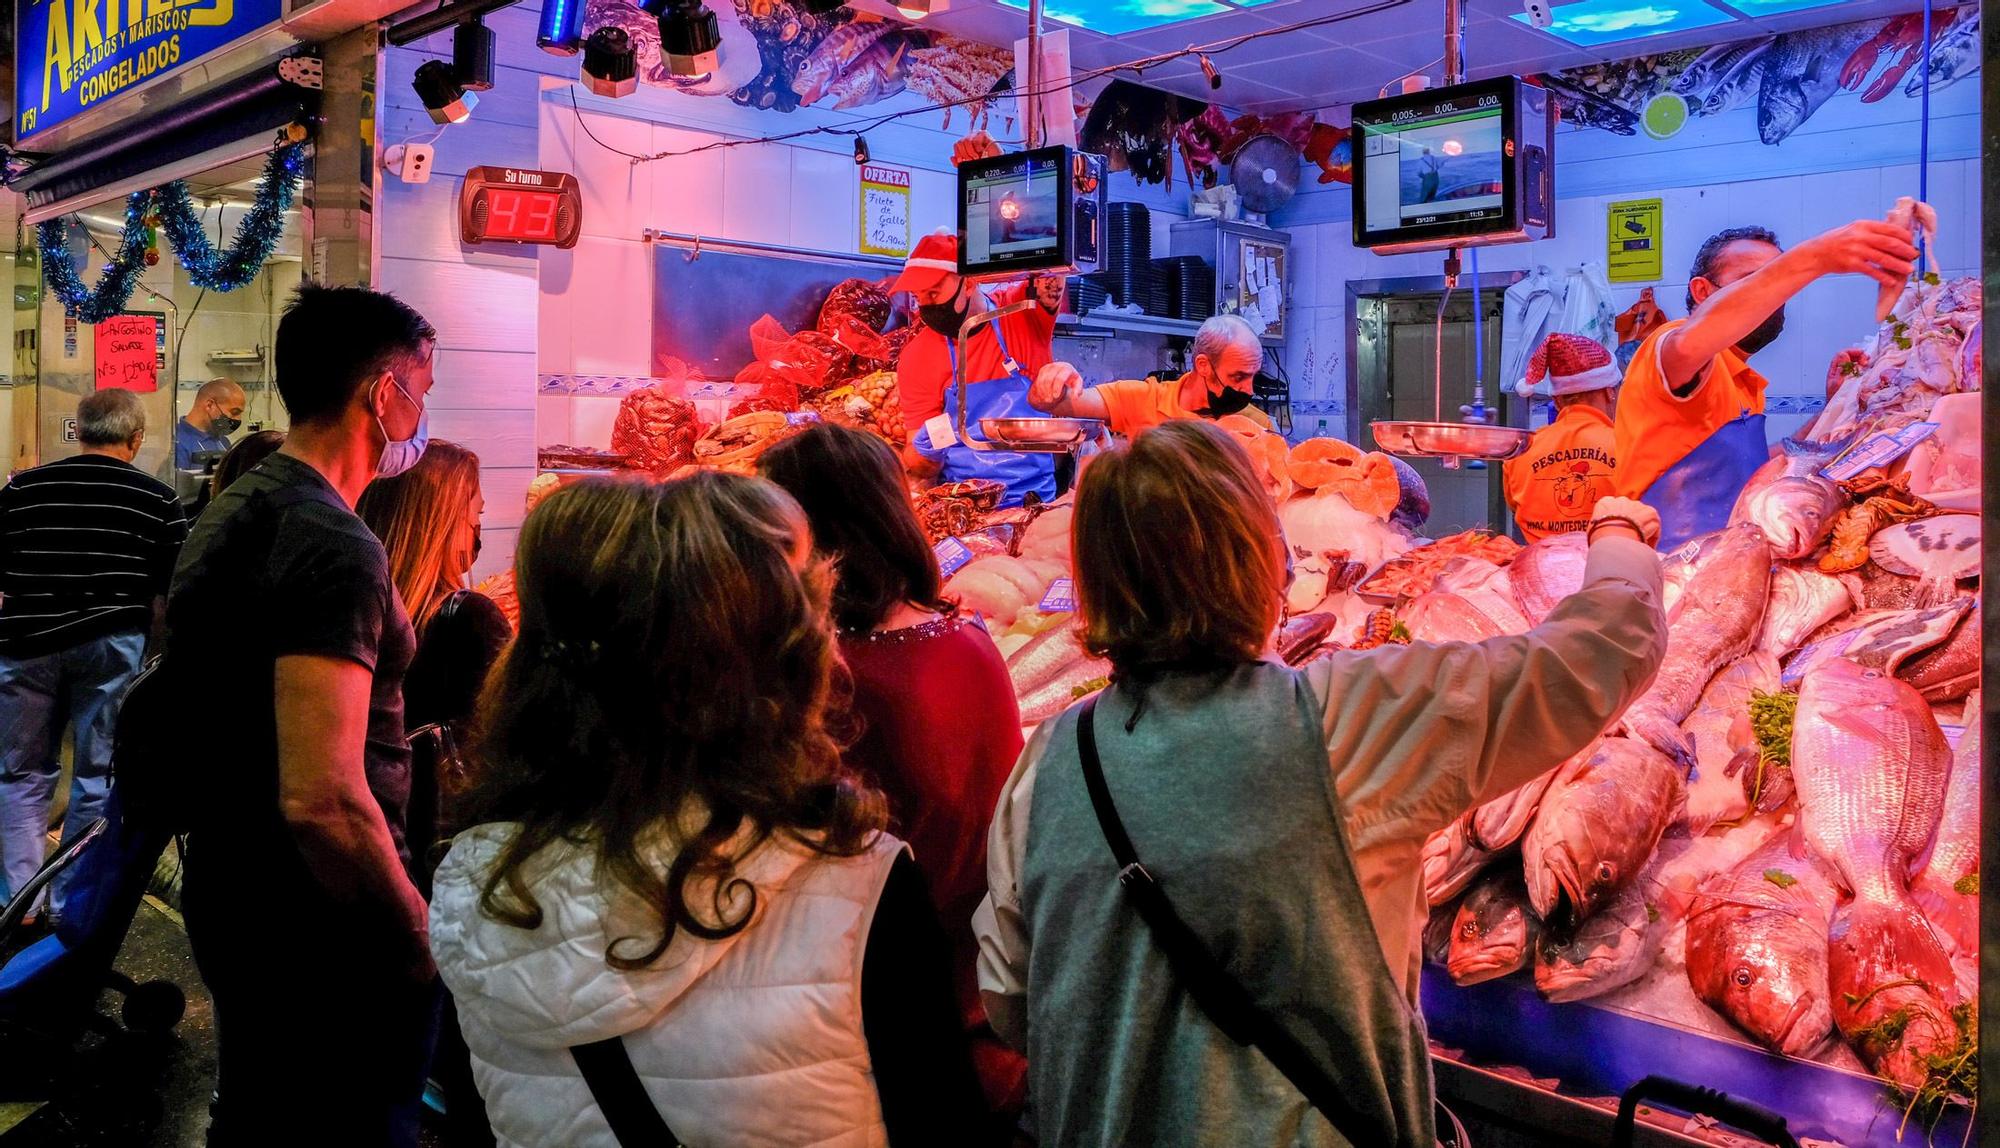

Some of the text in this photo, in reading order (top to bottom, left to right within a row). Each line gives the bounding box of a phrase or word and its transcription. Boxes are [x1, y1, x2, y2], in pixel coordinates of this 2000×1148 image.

[66, 9, 188, 84] PESCADOS Y MARISCOS
[79, 34, 180, 106] CONGELADOS
[505, 169, 542, 185] Su turno
[864, 167, 909, 185] OFERTA
[868, 193, 894, 207] Filete
[492, 194, 556, 236] 43
[880, 206, 892, 214] de
[879, 214, 906, 226] Gallo
[101, 319, 152, 337] LANGOSTINO
[1531, 447, 1617, 474] PESCADERÍAS
[1548, 520, 1590, 533] MONTESDE
